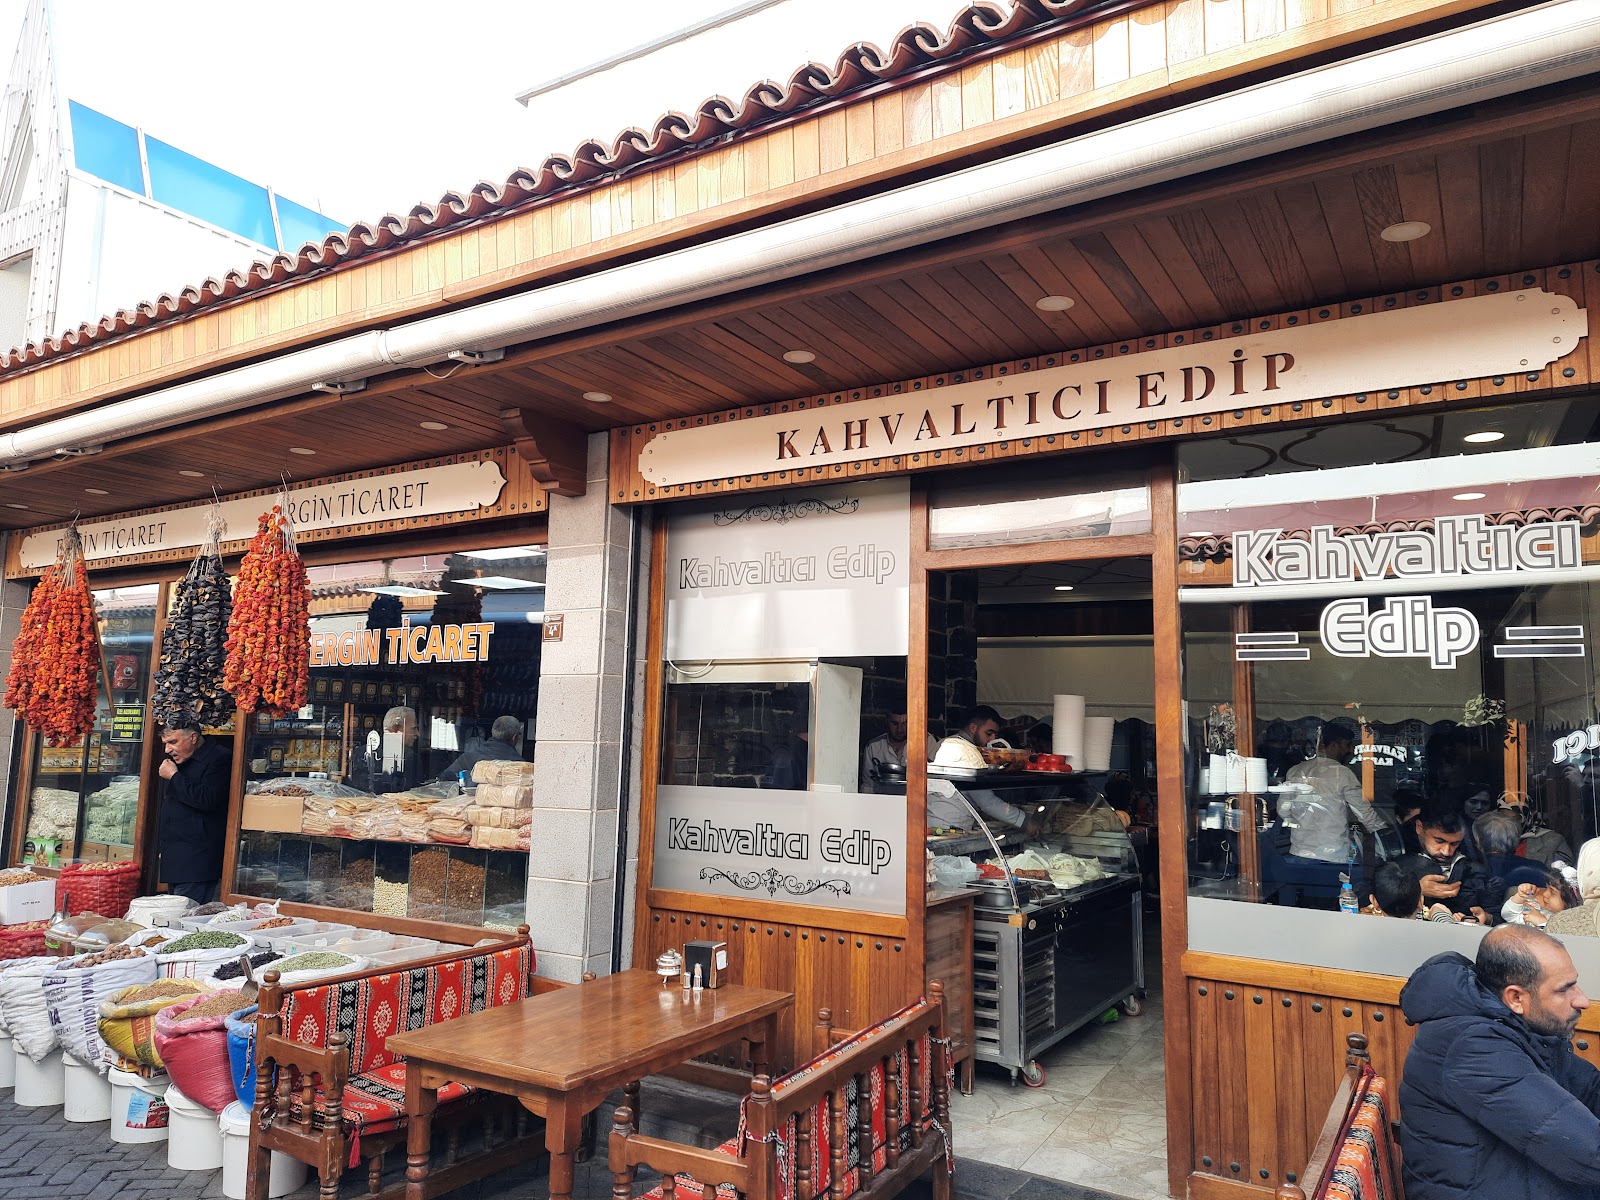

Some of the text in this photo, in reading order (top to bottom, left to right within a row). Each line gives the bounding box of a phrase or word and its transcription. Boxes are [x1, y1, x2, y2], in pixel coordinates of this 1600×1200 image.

[775, 348, 1296, 461] KAHVALTICI EDİP
[286, 481, 430, 525] RGİN TİCARET
[56, 522, 167, 558] EİN TİCARET
[678, 542, 896, 590] Kahvaltıcı Edip
[1232, 513, 1582, 588] Kahvaltıcı
[308, 617, 496, 668] ERGİN TİCARET
[1319, 595, 1480, 670] Edip
[667, 816, 893, 875] Kahvaltıcı Edip
